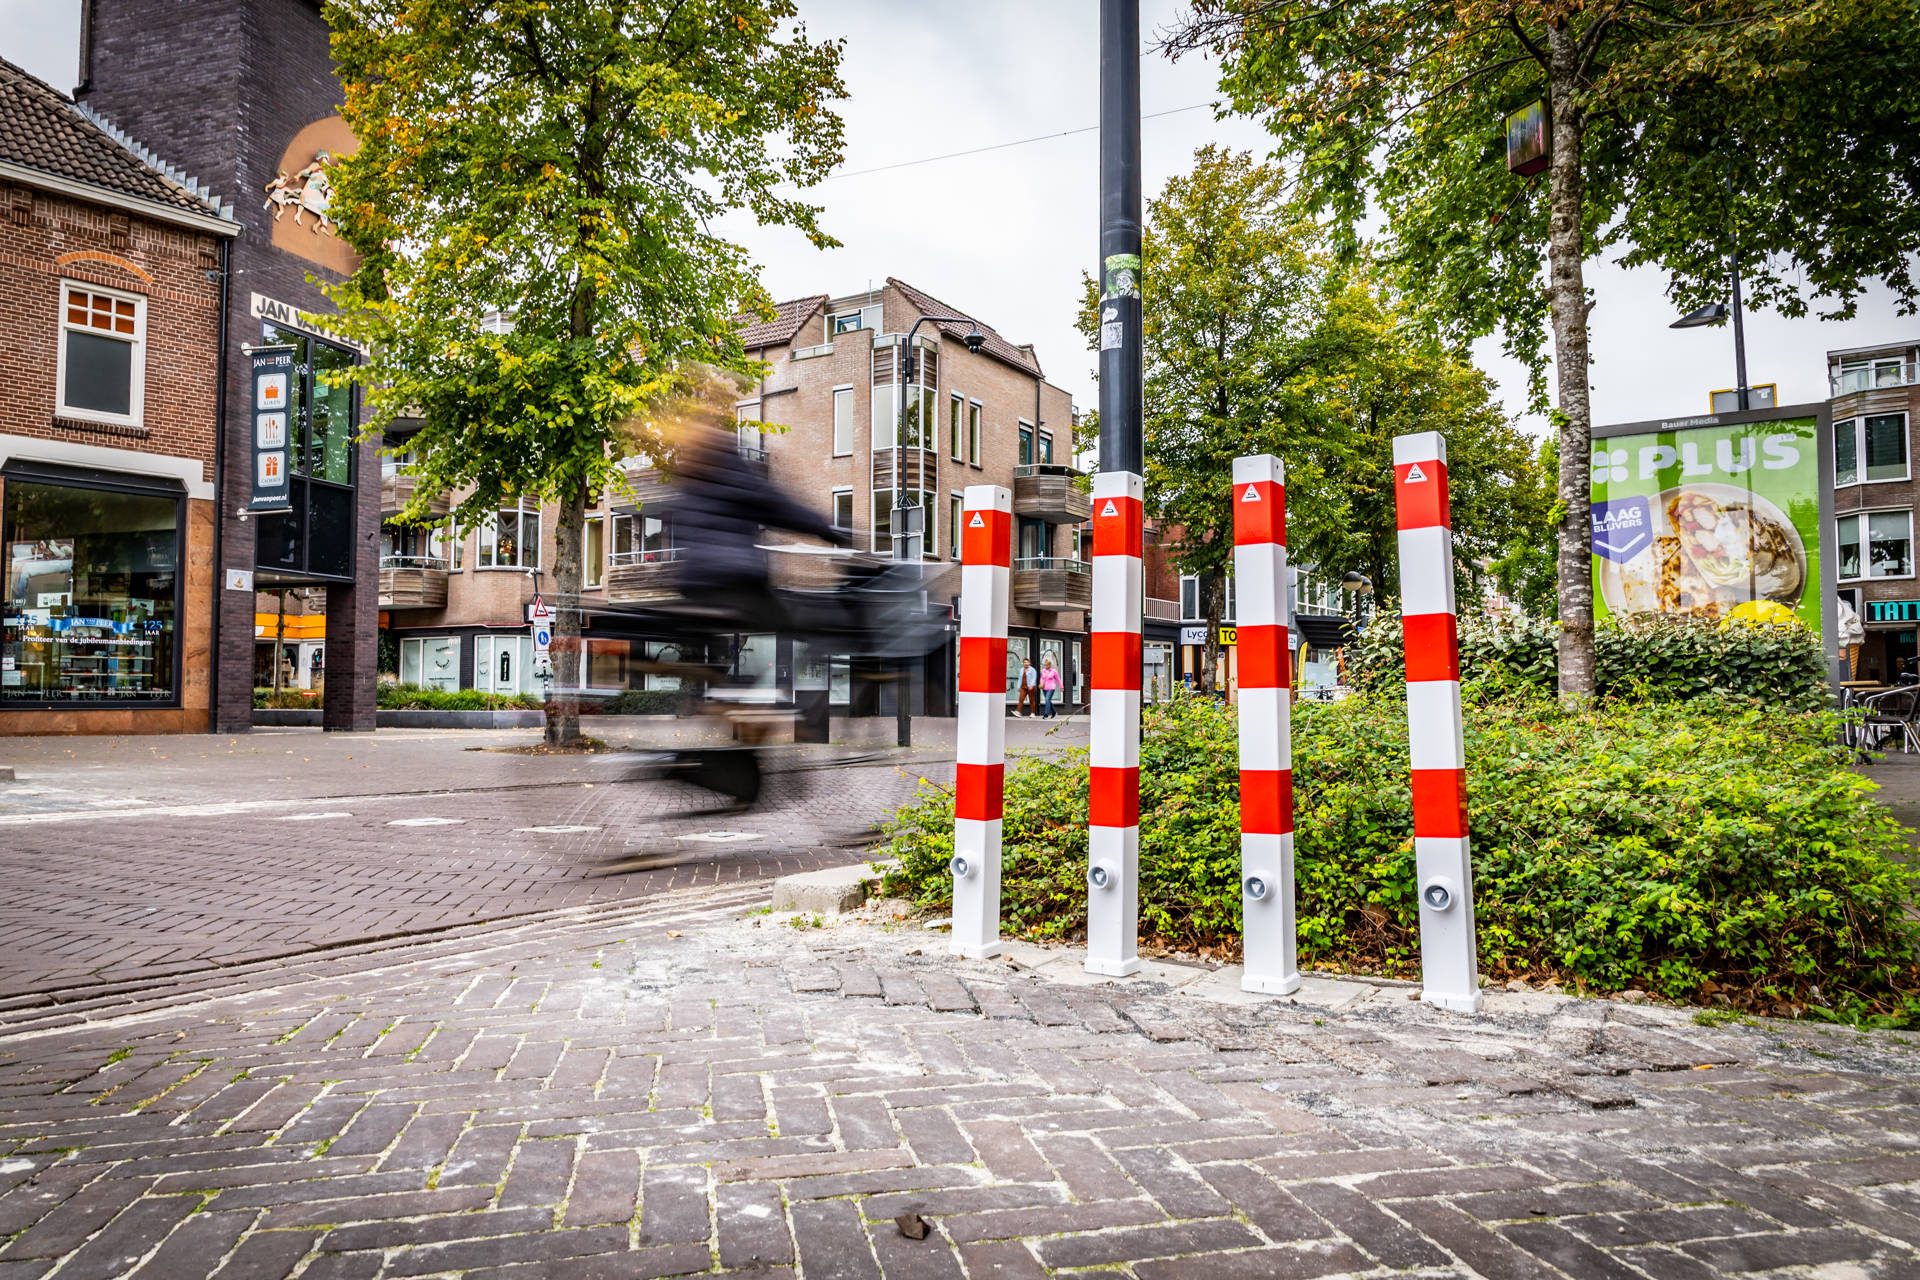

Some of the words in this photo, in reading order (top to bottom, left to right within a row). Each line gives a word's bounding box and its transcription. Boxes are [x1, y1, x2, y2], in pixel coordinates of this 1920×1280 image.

[256, 298, 290, 322] JAN
[253, 358, 266, 369] JAN
[275, 355, 291, 365] PEER
[1661, 421, 1688, 429] Bauer
[1690, 417, 1719, 426] Media
[1638, 433, 1800, 480] PLUS
[1592, 506, 1642, 525] LAAG
[1594, 519, 1643, 533] BLIJVERS
[143, 620, 163, 630] 125
[23, 635, 54, 643] Profiteer
